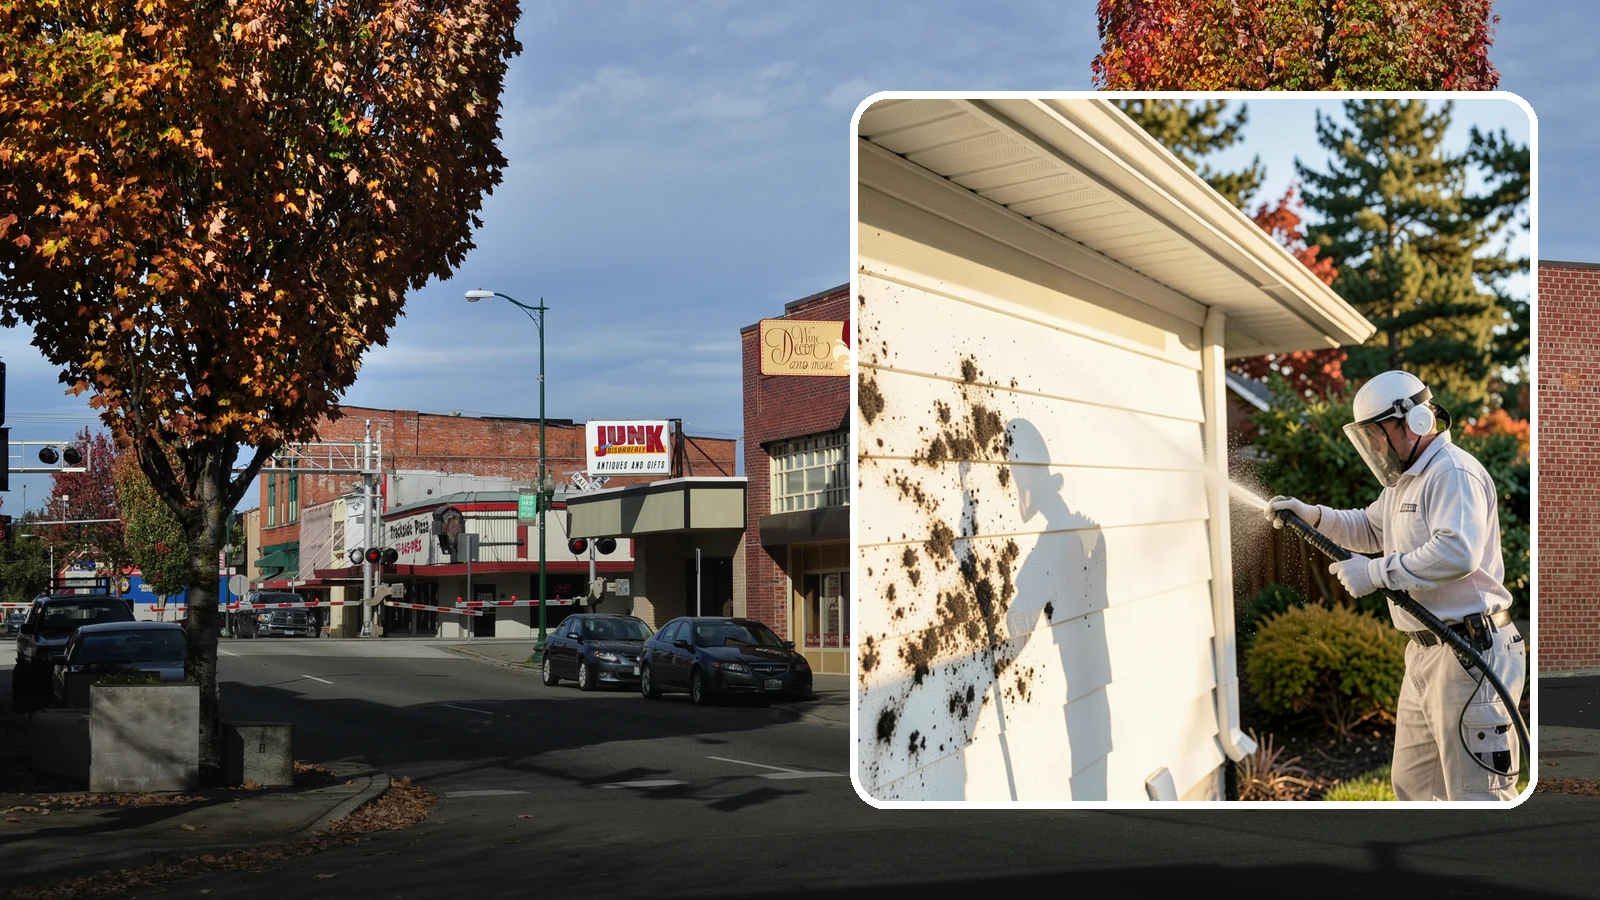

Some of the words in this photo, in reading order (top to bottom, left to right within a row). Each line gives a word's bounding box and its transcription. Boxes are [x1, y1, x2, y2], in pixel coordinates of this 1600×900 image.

[596, 425, 665, 457] JUNK
[607, 446, 646, 454] DISORDERLY
[597, 461, 628, 470] ANTIQUES
[631, 461, 644, 470] AND
[647, 460, 665, 470] GIFTS
[415, 519, 429, 535] Pizza
